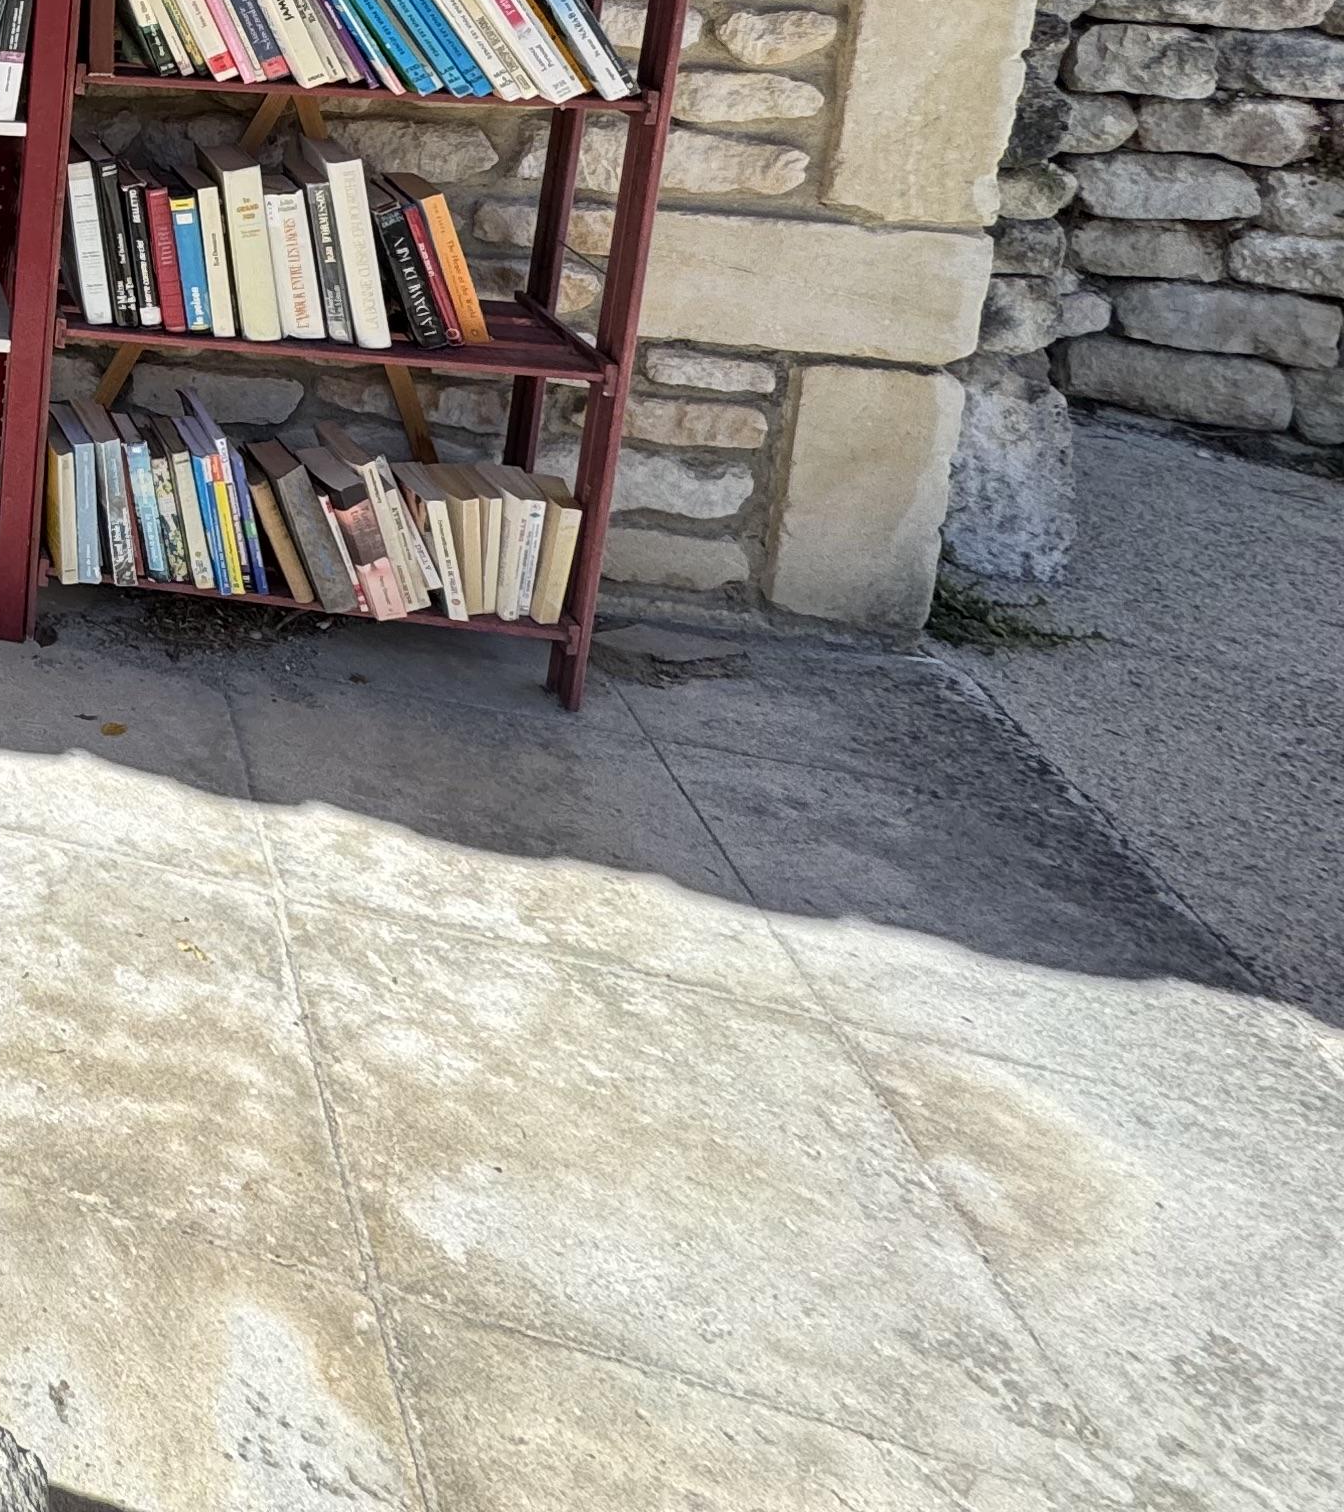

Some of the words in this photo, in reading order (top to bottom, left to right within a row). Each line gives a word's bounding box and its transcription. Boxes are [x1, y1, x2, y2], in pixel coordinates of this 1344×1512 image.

[315, 189, 332, 243] D'ORMESSON
[281, 217, 299, 247] LIGNES
[285, 247, 300, 263] LES
[322, 245, 335, 263] Jean
[288, 263, 305, 290] ENTRE
[292, 291, 310, 329] L'AMOUR
[408, 282, 430, 316] DAME
[419, 315, 437, 336] LA
